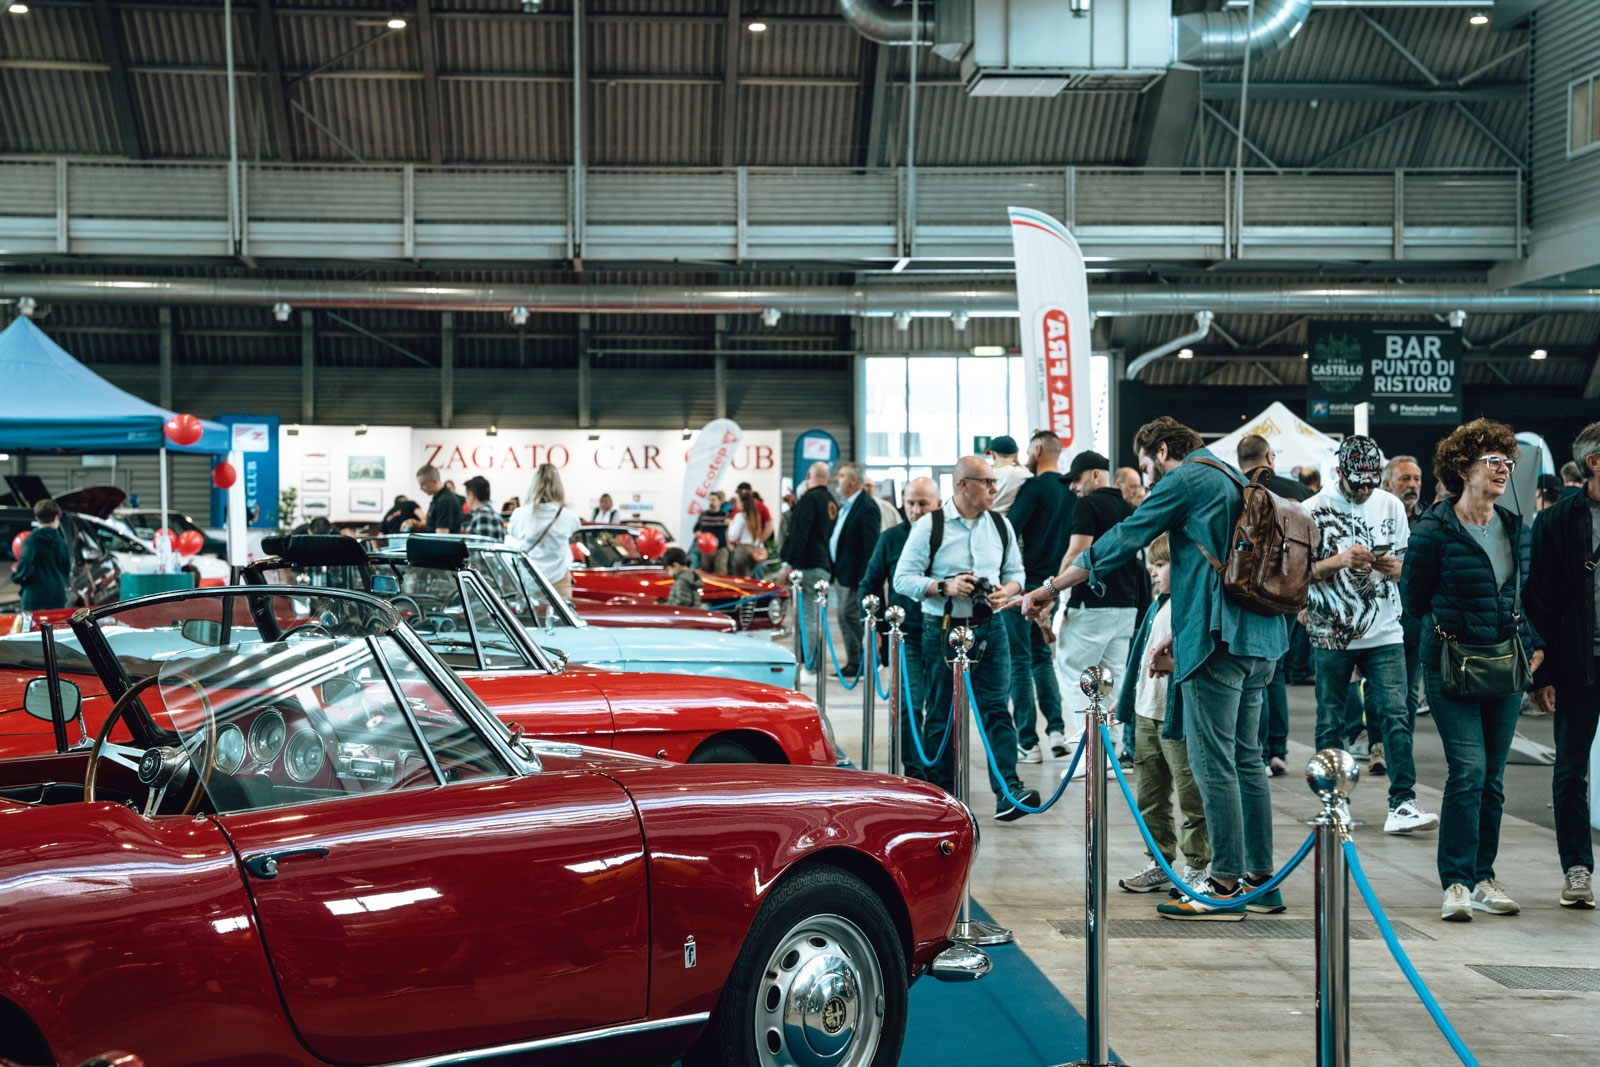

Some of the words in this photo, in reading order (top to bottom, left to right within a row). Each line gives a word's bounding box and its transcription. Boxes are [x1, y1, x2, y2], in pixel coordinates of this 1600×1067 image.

[1385, 335, 1441, 359] BAR
[1311, 364, 1364, 376] CASTELLO
[1371, 359, 1432, 375] PUNTO
[1436, 360, 1455, 376] DI
[1374, 376, 1452, 392] RISTORO
[424, 444, 570, 470] ZAGATO
[594, 446, 662, 470] CAR
[695, 447, 727, 499] Ecotop
